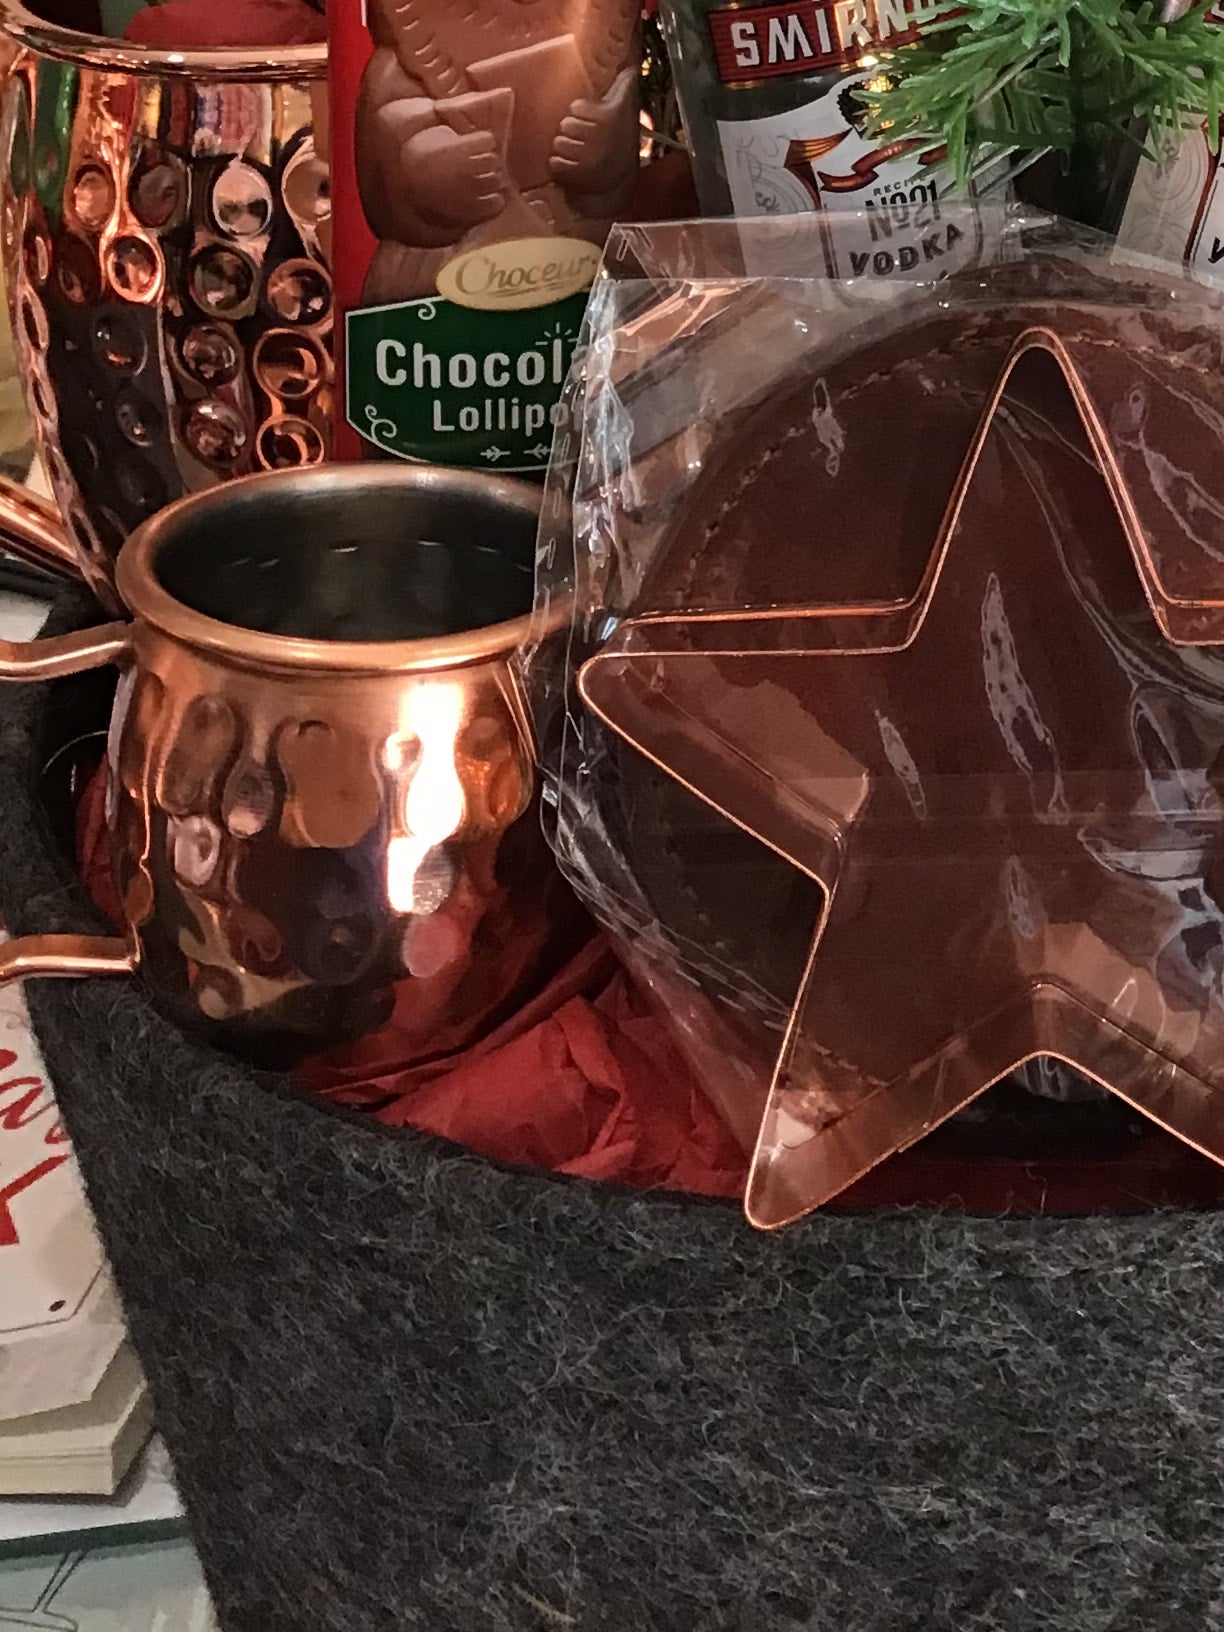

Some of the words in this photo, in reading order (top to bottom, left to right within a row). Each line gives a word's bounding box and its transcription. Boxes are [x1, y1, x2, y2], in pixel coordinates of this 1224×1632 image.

[455, 252, 598, 298] Choceur
[850, 223, 966, 279] VODKA
[375, 338, 563, 389] Chocol
